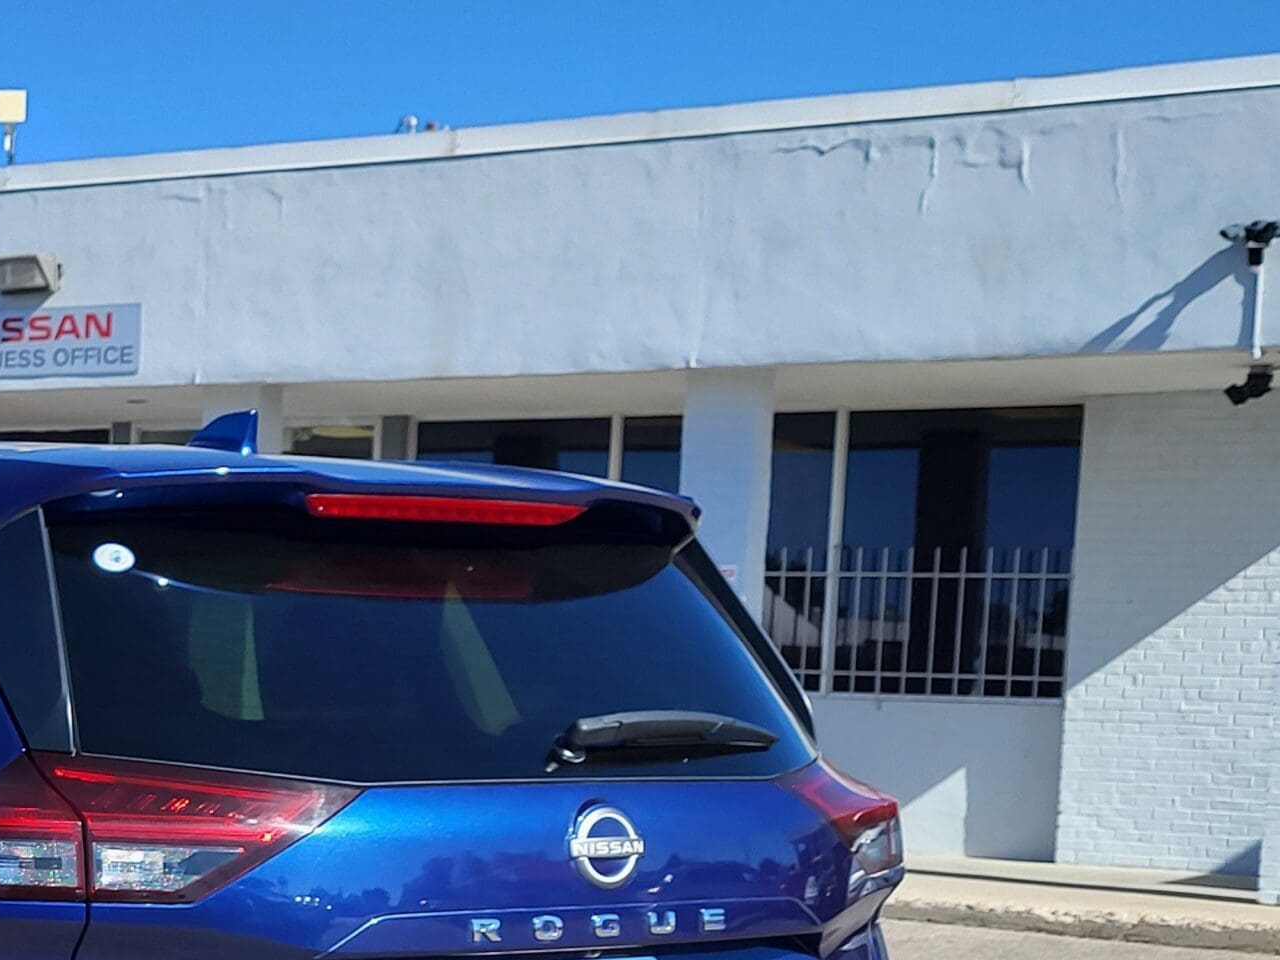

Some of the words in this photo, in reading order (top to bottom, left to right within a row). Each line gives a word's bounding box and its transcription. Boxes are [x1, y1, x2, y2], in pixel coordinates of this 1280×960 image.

[53, 345, 134, 367] OFFICE
[571, 839, 644, 857] NISSAN
[471, 907, 726, 943] ROGUE
